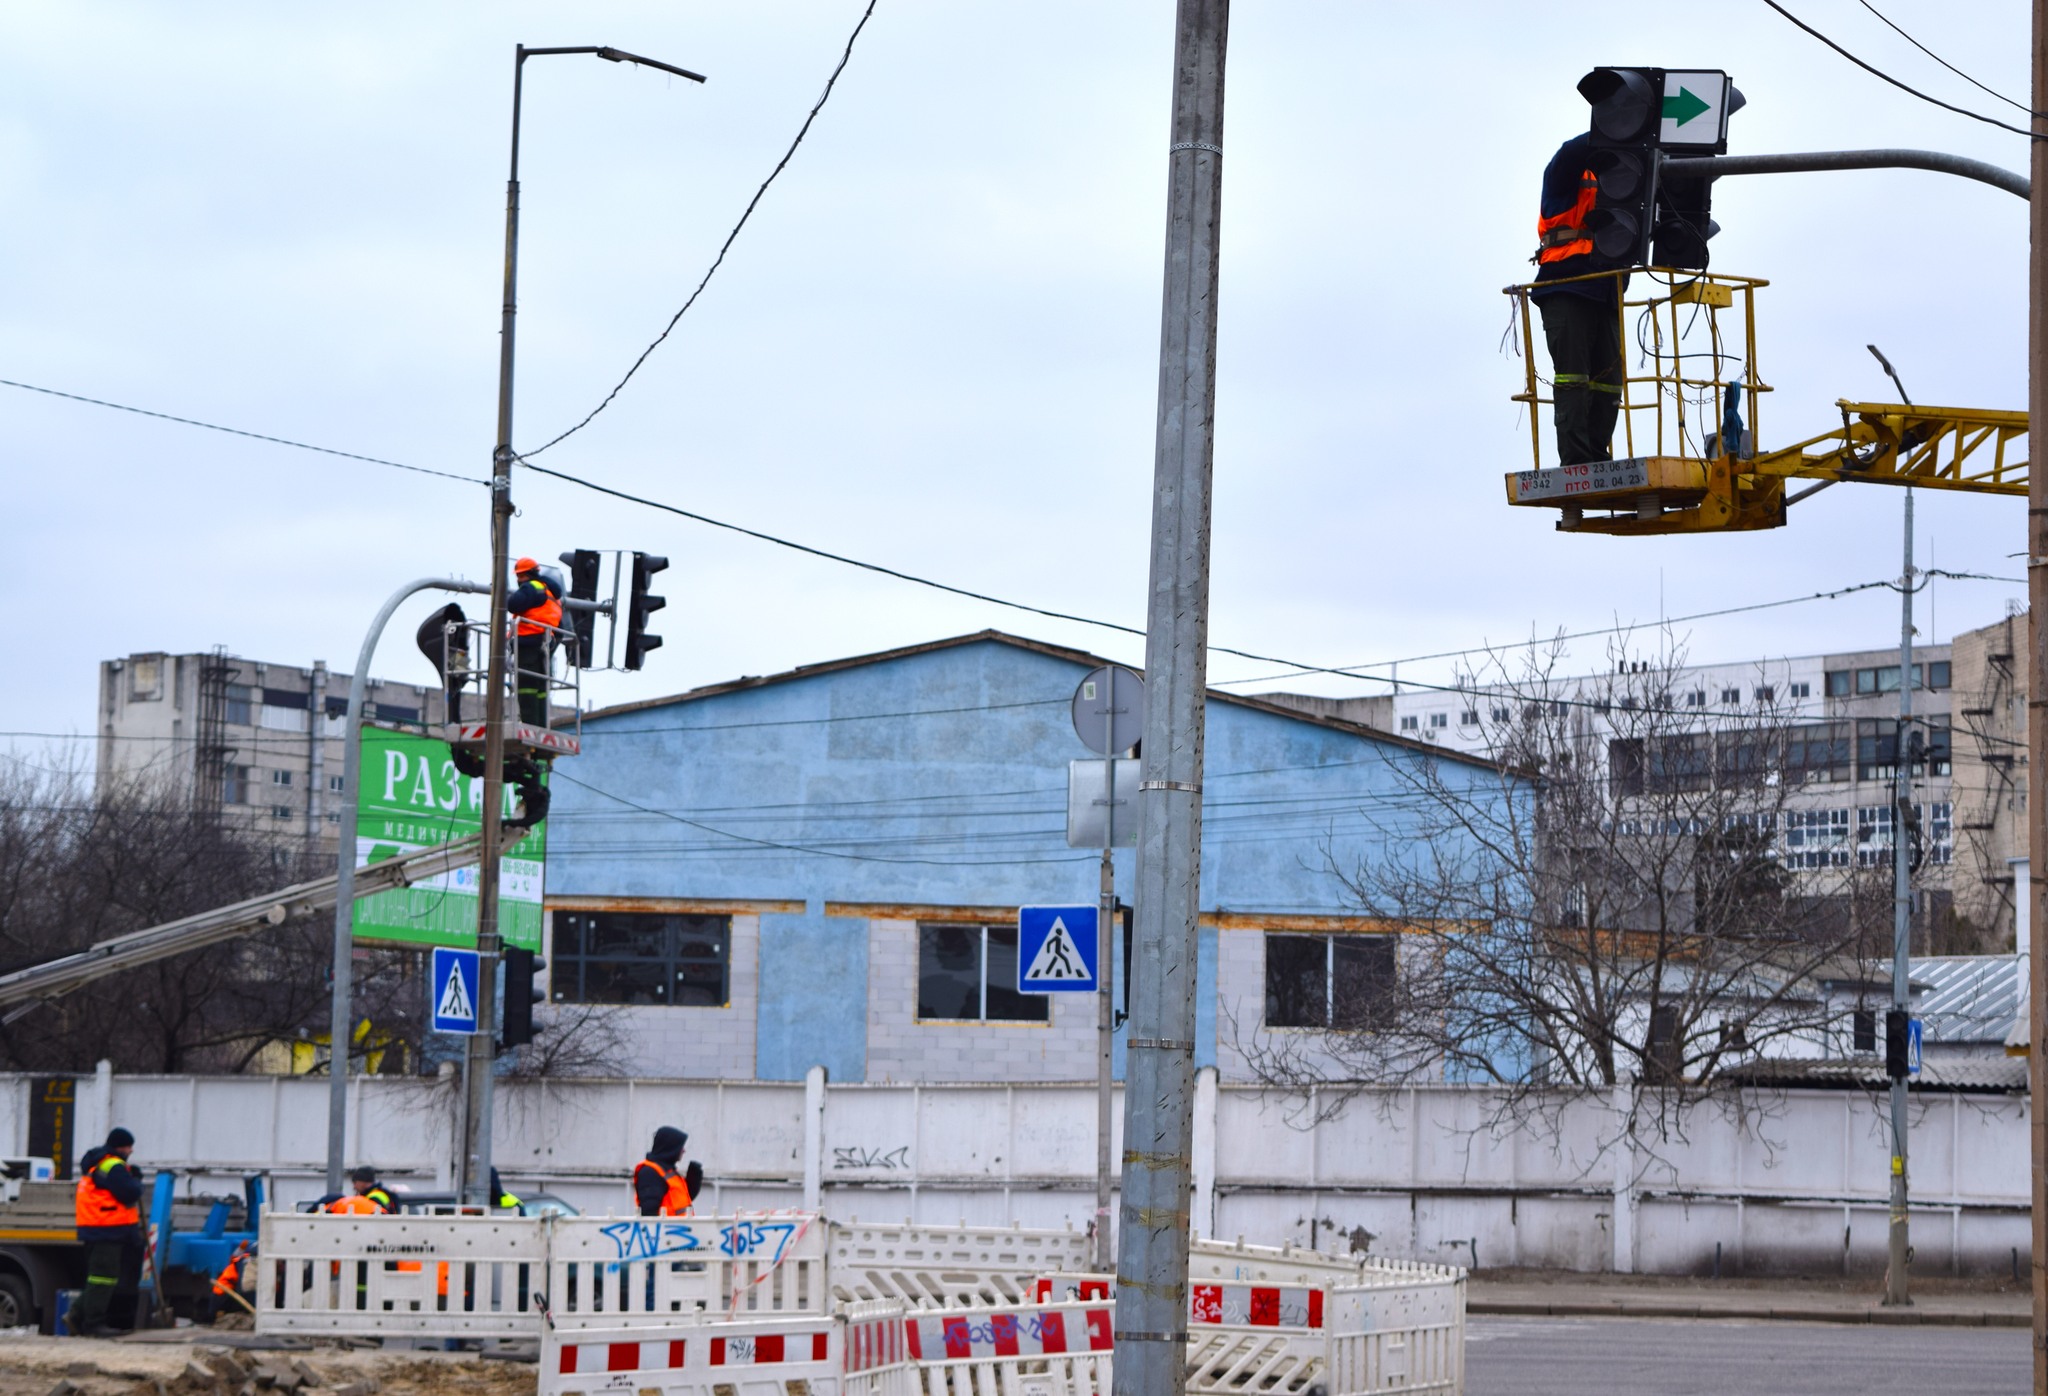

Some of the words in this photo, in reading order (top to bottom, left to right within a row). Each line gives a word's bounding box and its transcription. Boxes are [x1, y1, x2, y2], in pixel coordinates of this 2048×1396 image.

[1564, 465, 1589, 476] ЧТО
[1593, 460, 1637, 473] 23.06.23
[1521, 471, 1538, 480] 250
[1565, 480, 1590, 493] ПТО
